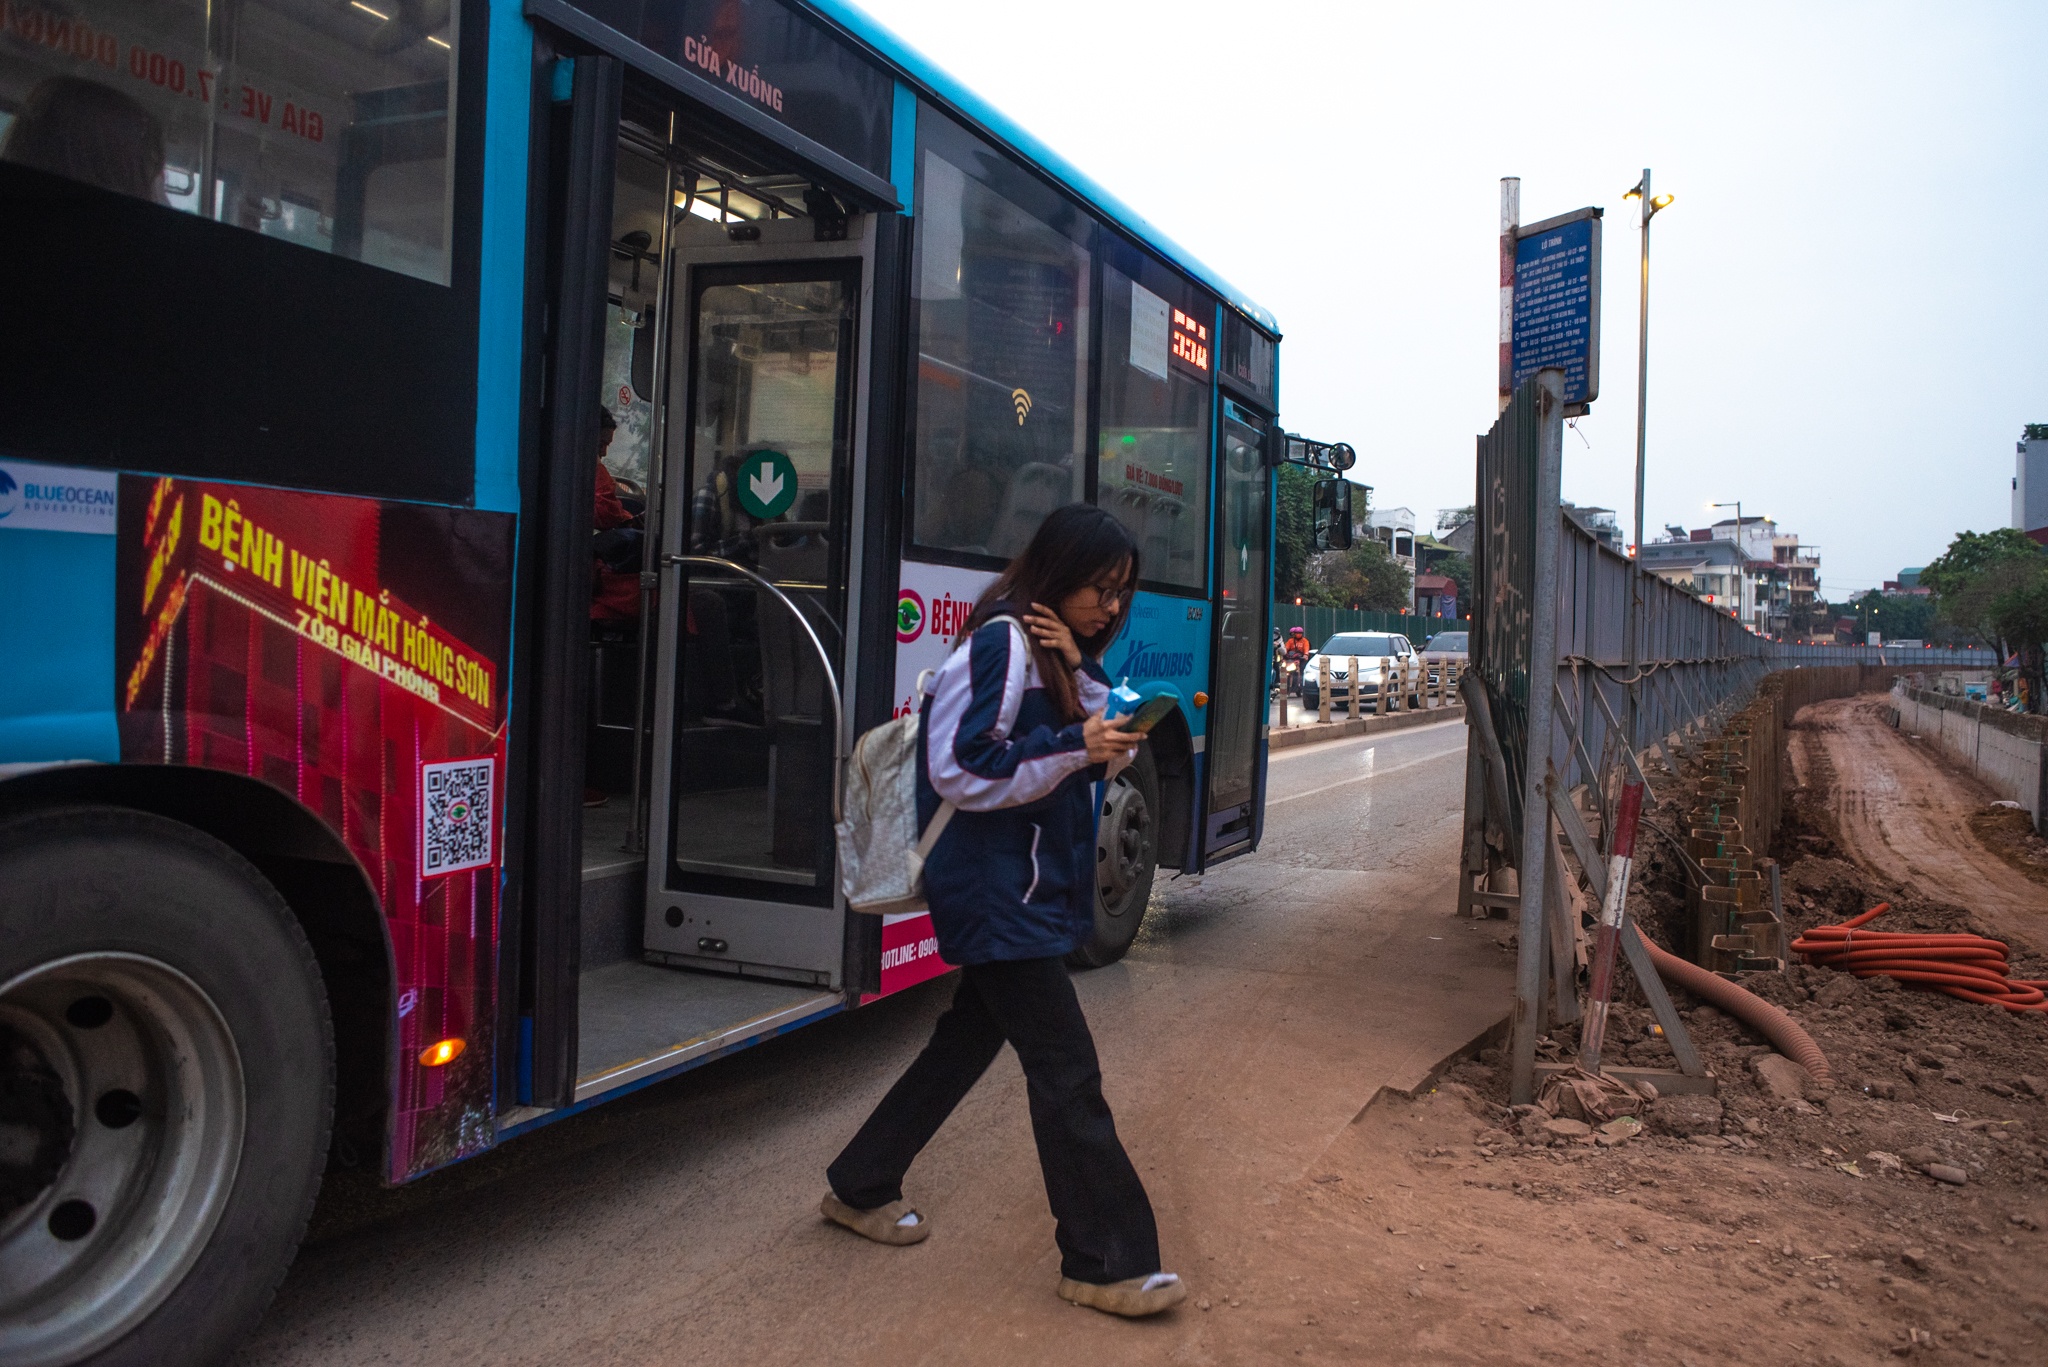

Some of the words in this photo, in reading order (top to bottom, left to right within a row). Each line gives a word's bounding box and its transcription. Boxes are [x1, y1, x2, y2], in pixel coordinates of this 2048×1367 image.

[684, 34, 721, 78] CỬA
[726, 59, 783, 113] XUỐNG
[24, 483, 114, 505] BLUEOCEAN
[25, 502, 114, 516] ADVERTISING
[200, 493, 284, 588] BỆNH
[456, 655, 490, 708] SƠN
[1116, 640, 1194, 678] HANOIBUS
